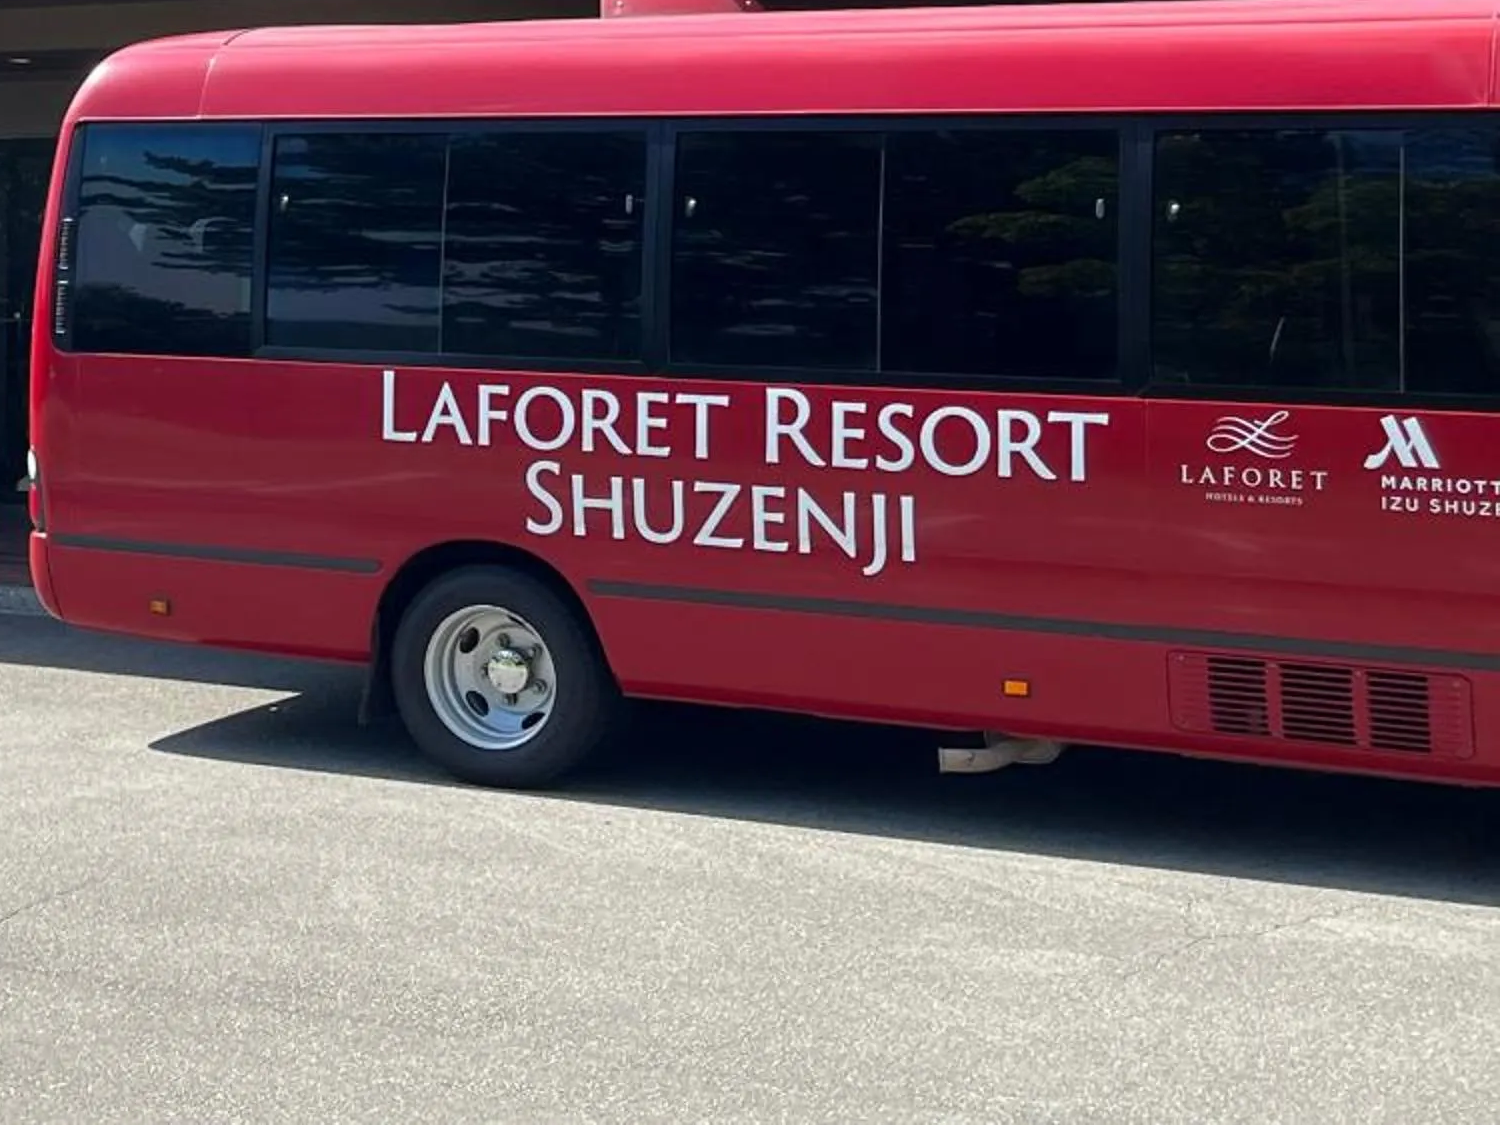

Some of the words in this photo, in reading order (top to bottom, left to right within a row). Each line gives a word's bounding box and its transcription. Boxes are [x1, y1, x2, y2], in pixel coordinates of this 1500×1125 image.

[382, 369, 730, 459] LAFORET
[765, 386, 1109, 482] RESORT
[1181, 464, 1328, 490] LAFORET
[1381, 474, 1500, 495] MARRIOTT
[1381, 496, 1419, 512] IZU
[525, 460, 916, 576] SHUZENJI
